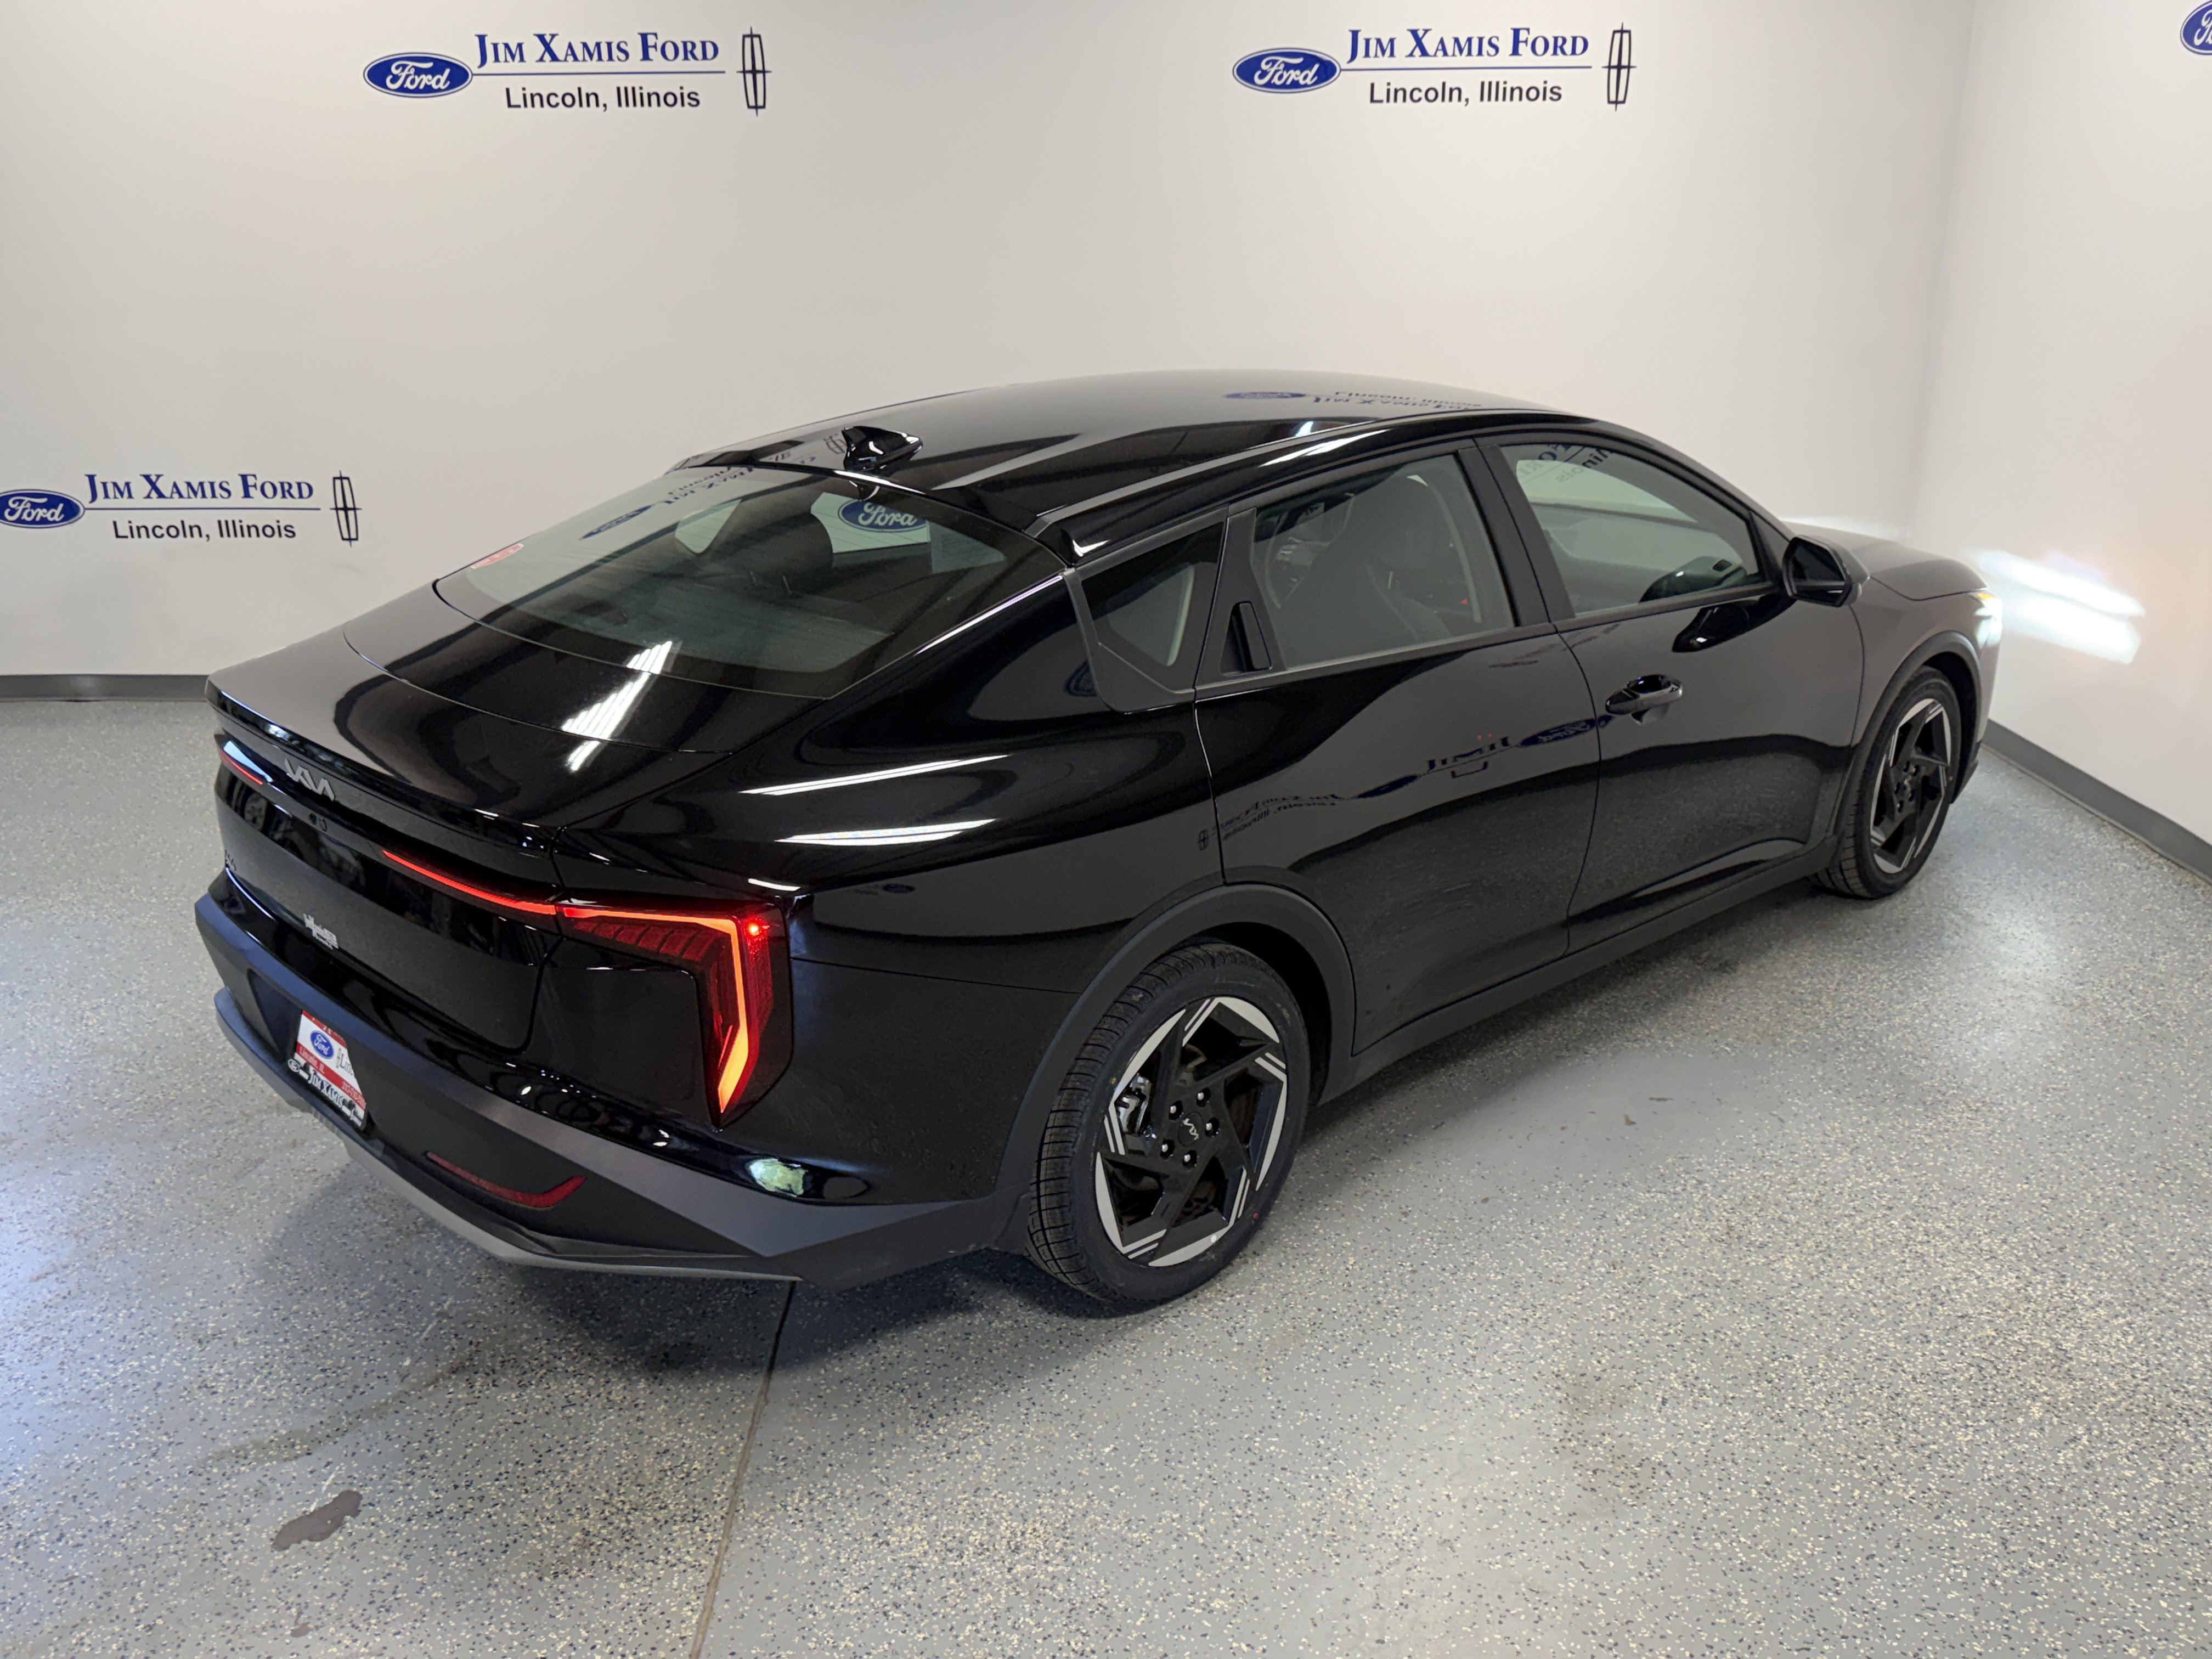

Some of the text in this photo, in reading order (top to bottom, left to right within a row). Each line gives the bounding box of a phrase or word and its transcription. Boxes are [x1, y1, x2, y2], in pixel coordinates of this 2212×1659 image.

[475, 32, 719, 69] JIM XAMIS FORD
[1347, 27, 1589, 64] JIM XAMIS FORD
[386, 60, 450, 91] Ford
[1254, 55, 1319, 87] Ford
[505, 86, 701, 112] Lincoln, Illinois
[1369, 80, 1562, 107] Lincoln, Illinois
[84, 473, 314, 504] JIM XAMIS FORD
[3, 495, 65, 523] Ford
[112, 520, 296, 542] Lincoln, Illinois
[314, 1034, 330, 1056] Ford
